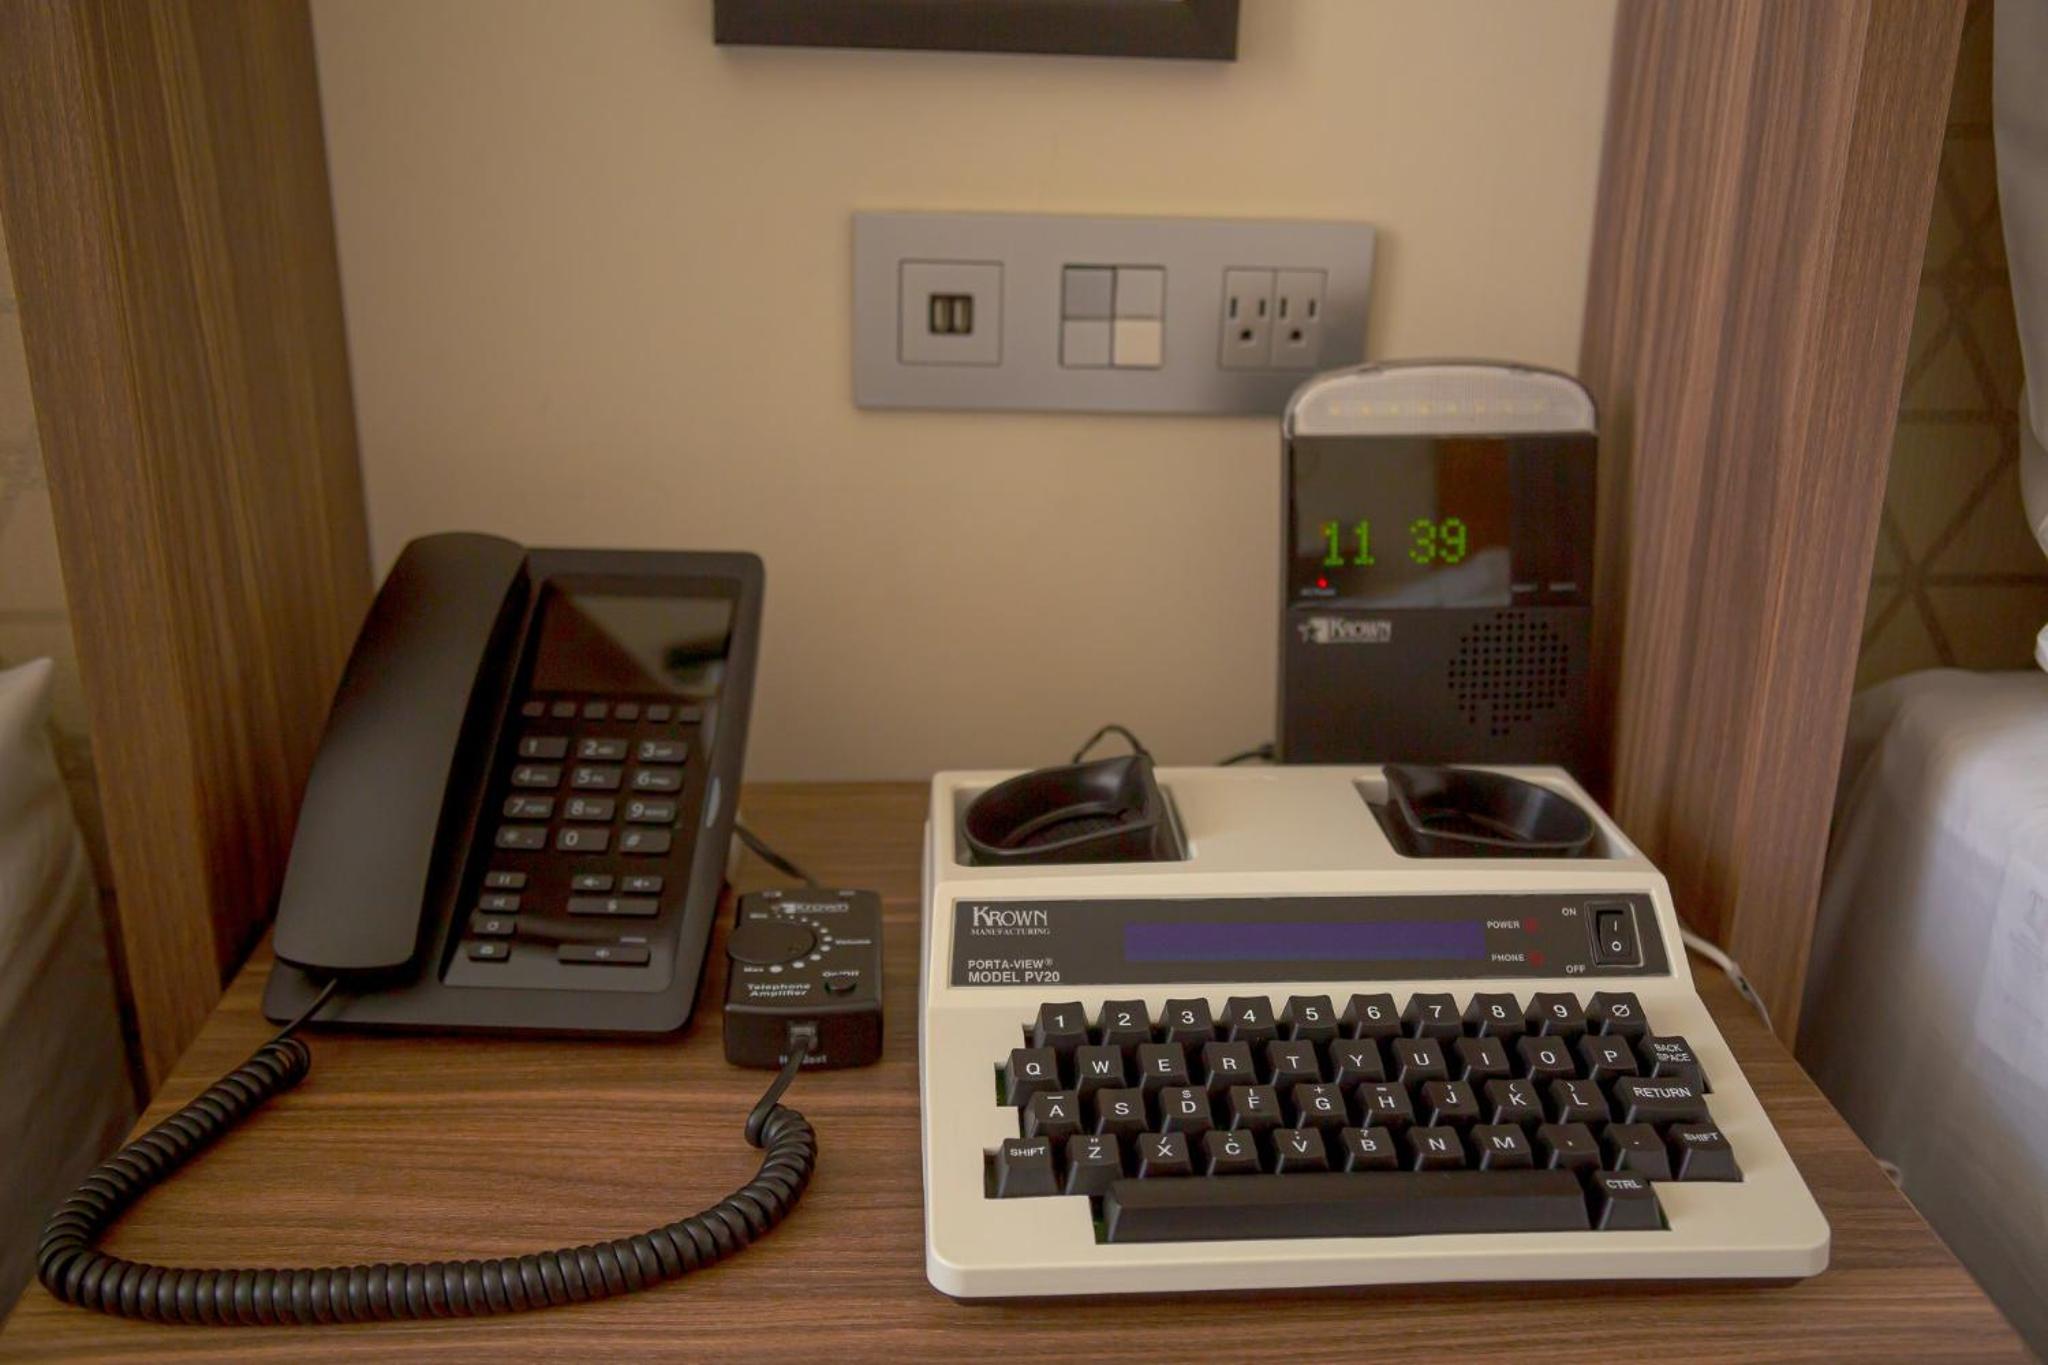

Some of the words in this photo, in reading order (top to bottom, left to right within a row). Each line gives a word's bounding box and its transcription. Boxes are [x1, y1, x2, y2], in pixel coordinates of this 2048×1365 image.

[1323, 520, 1375, 567] 11
[1407, 517, 1468, 565] 39
[529, 739, 538, 754] 1
[584, 741, 598, 755] 2
[643, 742, 656, 757] 3
[518, 769, 531, 781] 4
[578, 768, 591, 783] 5
[637, 771, 650, 786] 6
[512, 799, 525, 813] 7
[571, 800, 585, 815] 8
[631, 803, 644, 817] 9
[565, 831, 579, 845] 0
[1561, 907, 1577, 917] ON
[1487, 920, 1520, 929] POWER
[971, 927, 1050, 936] MANUFACTURING
[1491, 953, 1525, 962] PHONE
[1565, 964, 1586, 974] OFF
[968, 971, 1020, 983] MODEL
[1025, 971, 1060, 983] PV20
[747, 983, 811, 992] Telephone
[750, 990, 808, 998] Amplifier
[1181, 1010, 1195, 1025] 3
[1243, 1009, 1256, 1023] 4
[1305, 1007, 1319, 1021] 5
[1367, 1006, 1381, 1020] 6
[1429, 1005, 1442, 1019] 7
[1491, 1005, 1506, 1018] 8
[1552, 1004, 1568, 1018] 9
[1054, 1014, 1065, 1029] 1
[1117, 1012, 1132, 1027] 2
[1654, 1043, 1684, 1053] BACK
[1286, 1055, 1300, 1069] T
[1348, 1054, 1363, 1067] Y
[1413, 1052, 1431, 1066] U
[1540, 1051, 1556, 1064] O
[1603, 1050, 1618, 1063] P
[1656, 1053, 1691, 1062] SPACE
[1026, 1062, 1042, 1076] Q
[1091, 1060, 1110, 1074] W
[1157, 1058, 1172, 1072] E
[1222, 1057, 1237, 1070] R
[1632, 1087, 1692, 1098] RETURN
[1248, 1096, 1261, 1109] F
[1315, 1098, 1331, 1111] G
[1378, 1096, 1396, 1109] H
[1508, 1093, 1527, 1106] K
[1572, 1093, 1589, 1106] L
[1049, 1105, 1065, 1117] A
[1114, 1102, 1129, 1115] S
[1182, 1101, 1196, 1114] D
[1492, 1136, 1516, 1149] M
[1683, 1132, 1719, 1141] SHIFT
[1157, 1144, 1174, 1157] X
[1225, 1143, 1241, 1155] C
[1291, 1141, 1308, 1153] V
[1361, 1139, 1377, 1152] B
[1428, 1138, 1446, 1151] N
[1010, 1146, 1046, 1157] SHIFT
[1088, 1146, 1102, 1159] Z
[1606, 1179, 1643, 1189] CTRL
